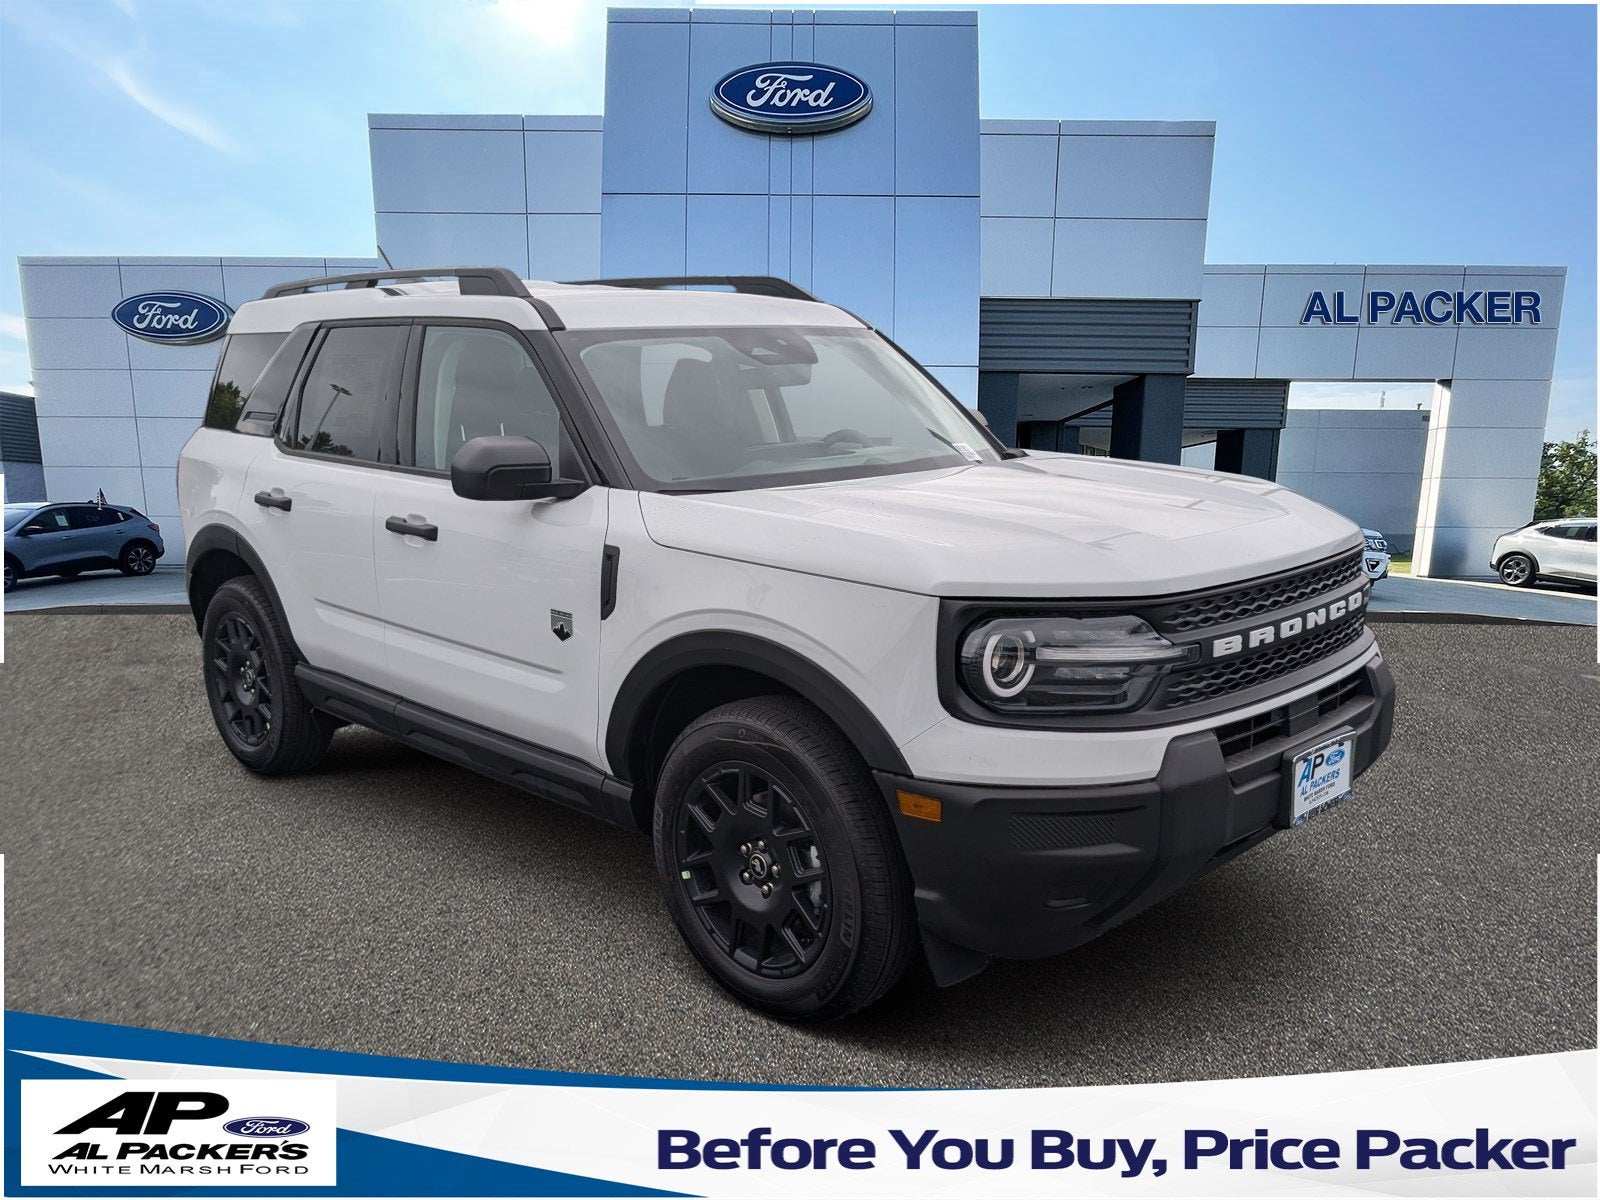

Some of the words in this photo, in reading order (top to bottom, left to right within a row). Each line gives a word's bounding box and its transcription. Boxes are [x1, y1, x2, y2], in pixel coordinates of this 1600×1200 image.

[747, 73, 835, 107] Ford
[133, 301, 198, 329] Ford
[1301, 290, 1359, 324] AL
[1368, 289, 1542, 324] PACKER
[1212, 591, 1363, 658] BRONCO
[1297, 752, 1325, 788] AP
